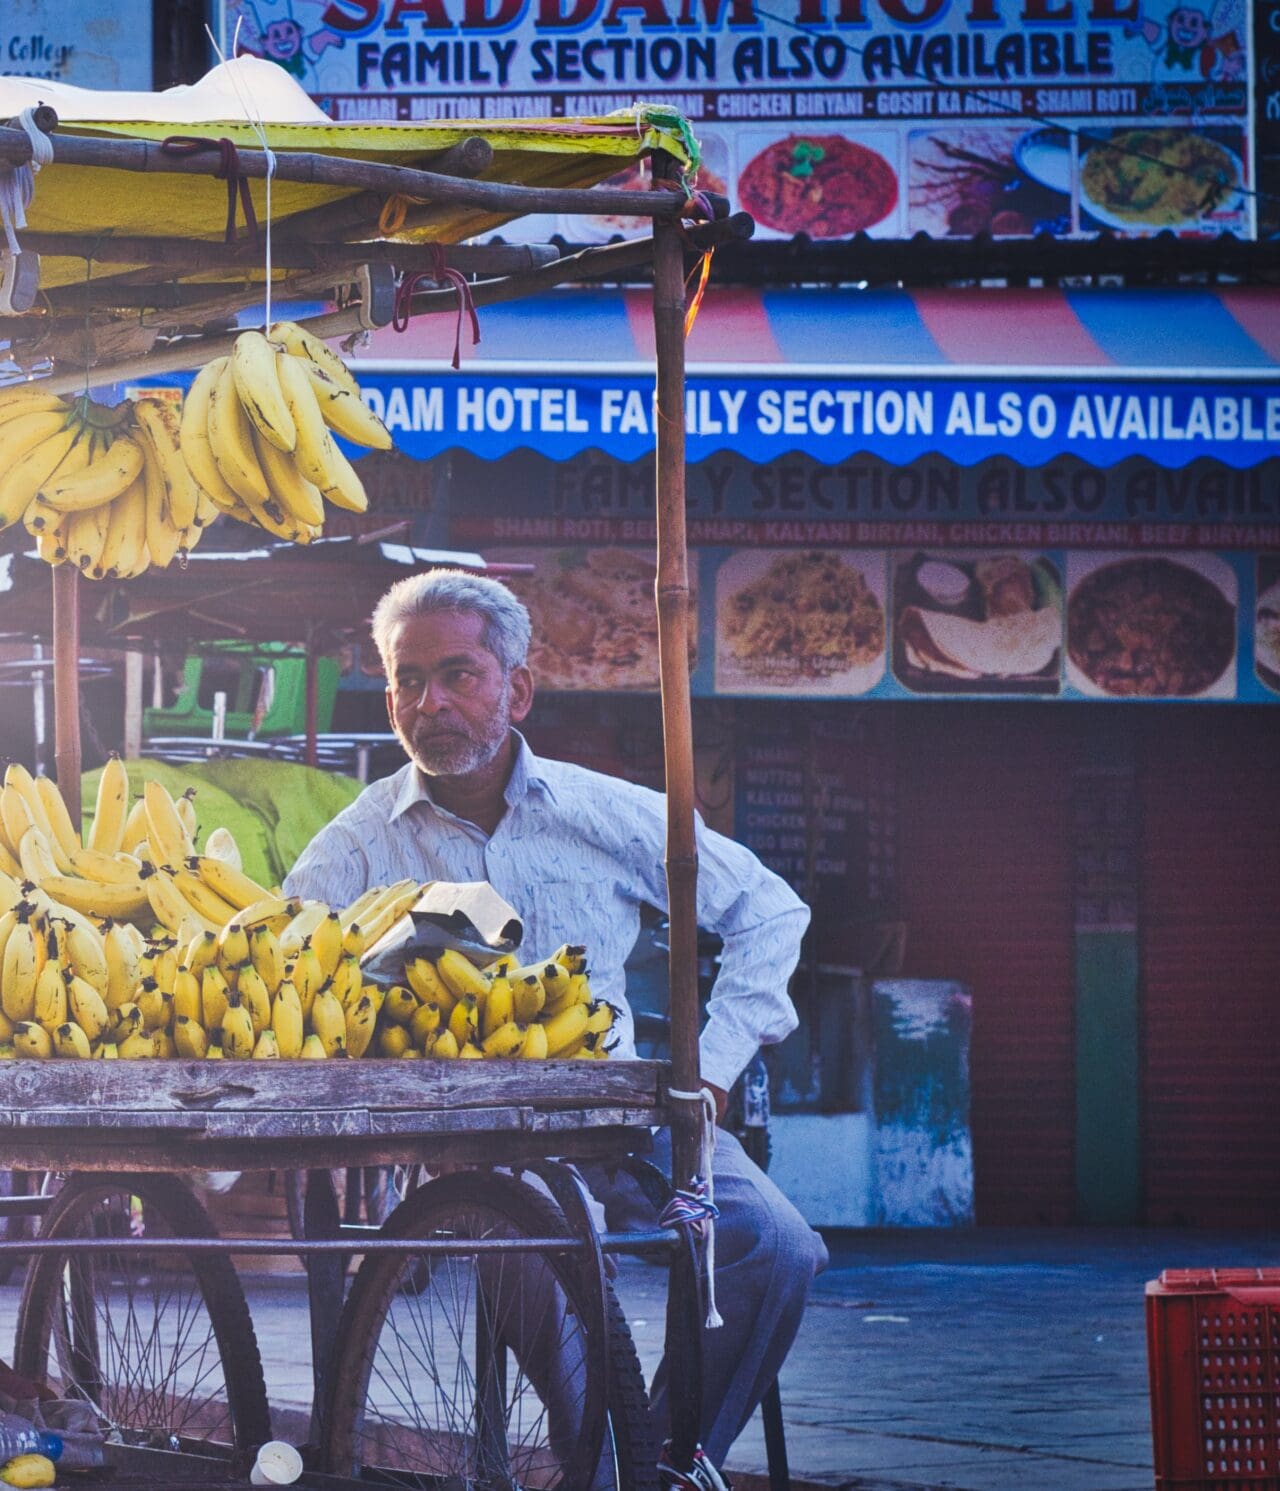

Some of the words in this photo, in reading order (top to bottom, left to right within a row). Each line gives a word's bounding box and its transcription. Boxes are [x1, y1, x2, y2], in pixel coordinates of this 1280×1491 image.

[357, 37, 517, 87] FAMILY
[530, 36, 717, 82] SECTION
[733, 34, 846, 83] ALSO
[863, 33, 1114, 82] AVAILABLE
[410, 97, 480, 121] MUTTON
[484, 96, 552, 119] BIRYANI
[717, 93, 791, 117] CHICKEN
[796, 92, 863, 115] BIRYANI
[877, 91, 932, 114] GOSHT
[938, 91, 961, 113] KA
[1036, 90, 1093, 112] SHAMI
[457, 387, 588, 433] HOTEL
[601, 389, 747, 435] FAILY
[757, 390, 933, 436] SECTION
[945, 391, 1057, 439] ALSO
